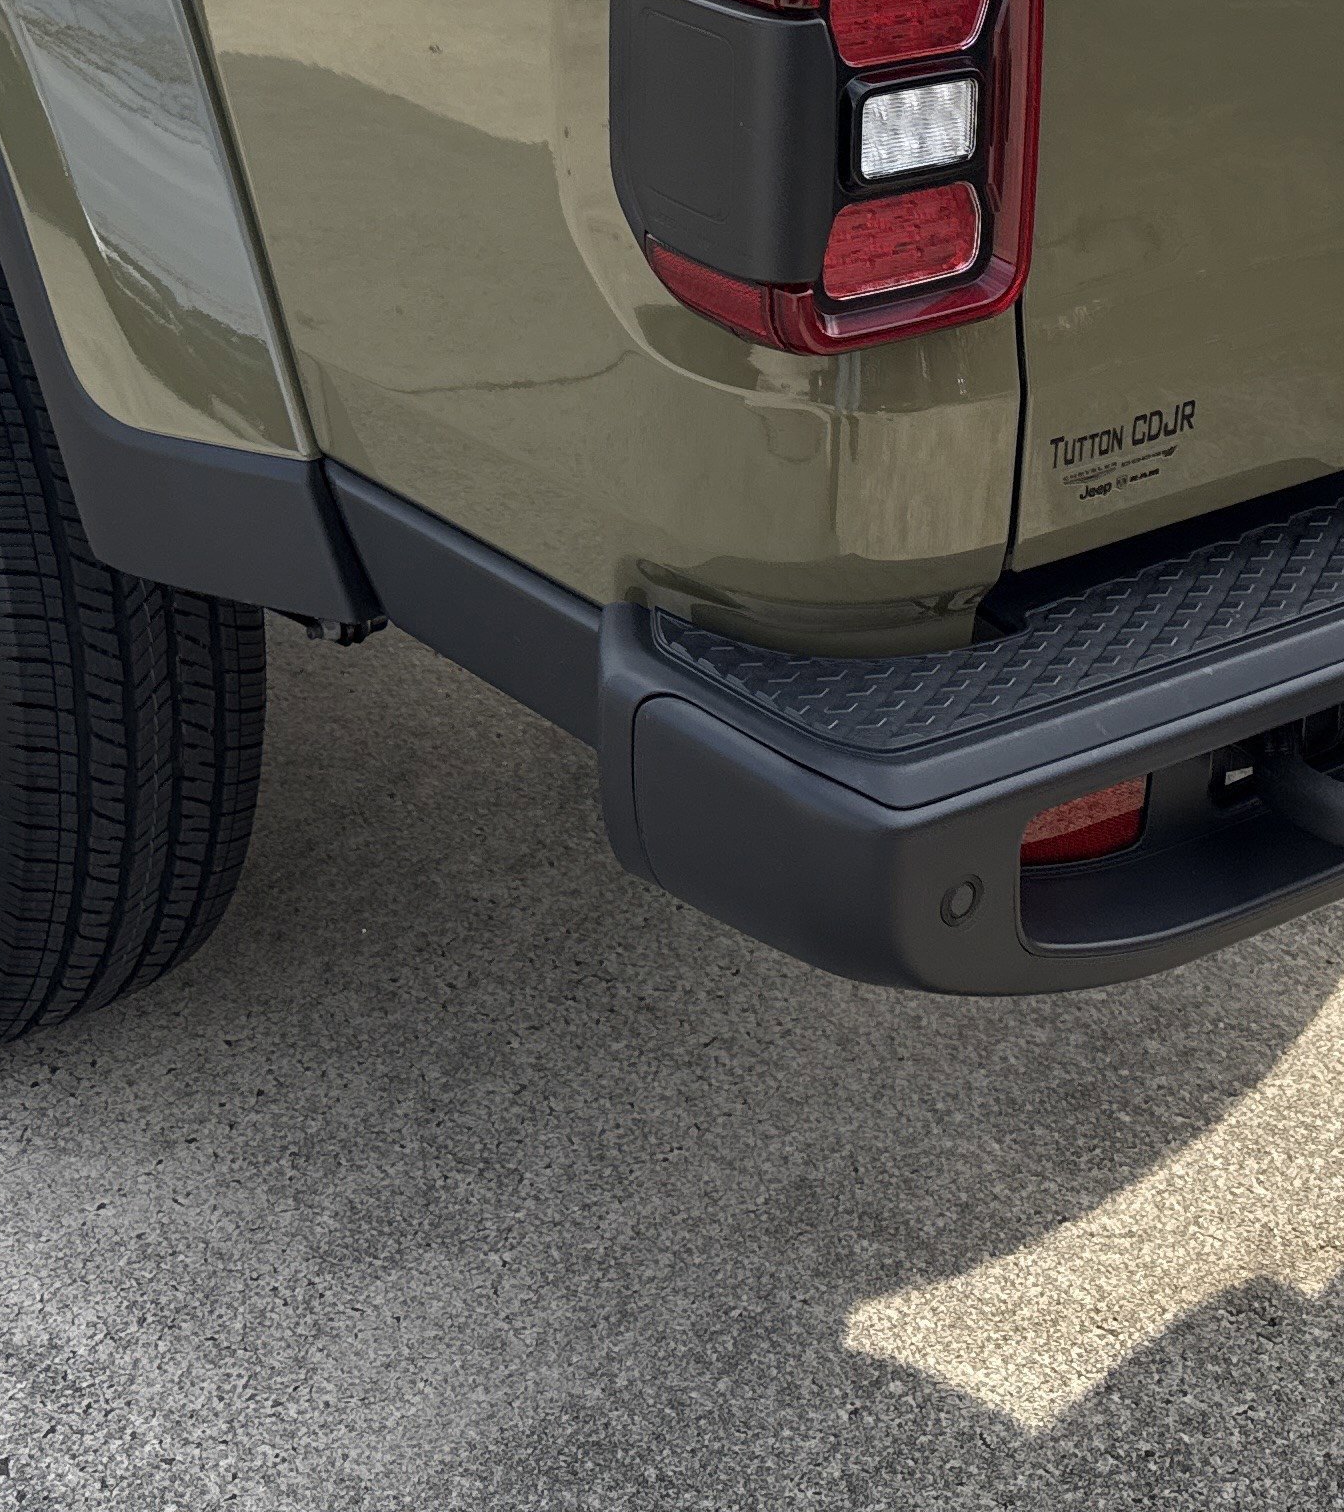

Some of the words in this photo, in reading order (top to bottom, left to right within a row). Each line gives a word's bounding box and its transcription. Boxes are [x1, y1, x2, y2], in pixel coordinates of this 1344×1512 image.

[1049, 424, 1124, 469] TUTTON
[1131, 399, 1196, 446] CDJR
[1079, 481, 1113, 501] Jeep
